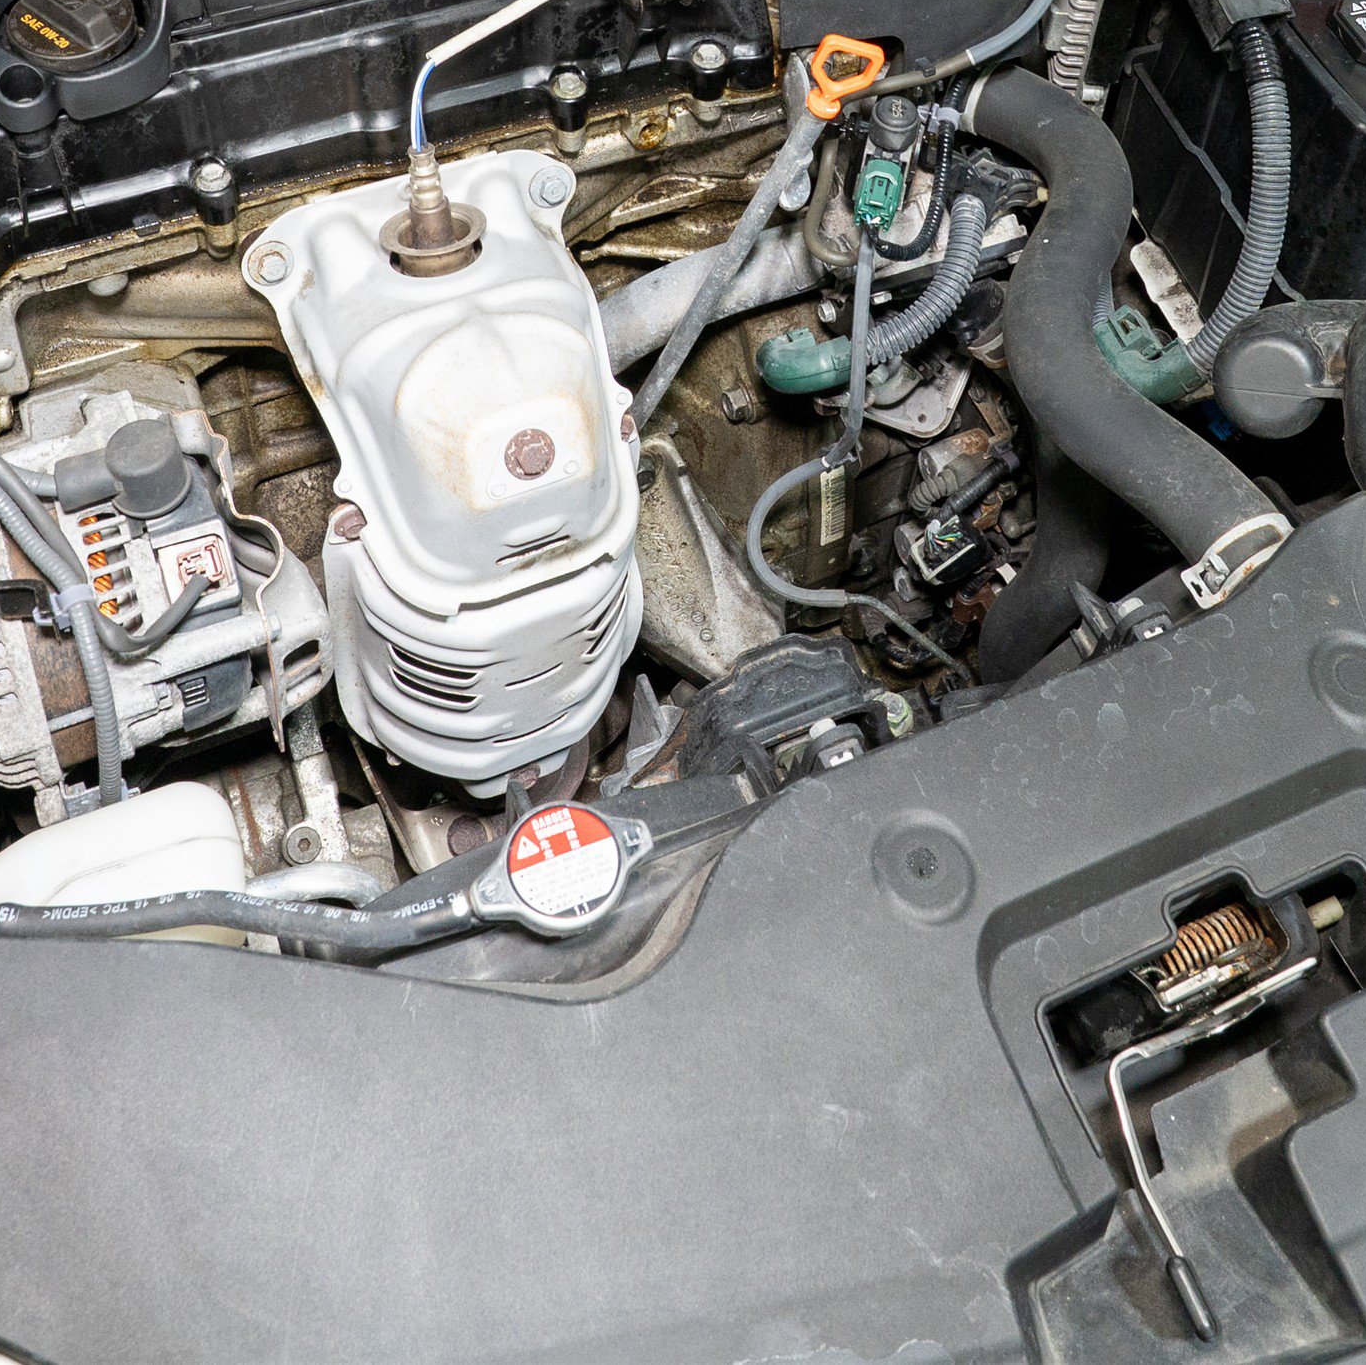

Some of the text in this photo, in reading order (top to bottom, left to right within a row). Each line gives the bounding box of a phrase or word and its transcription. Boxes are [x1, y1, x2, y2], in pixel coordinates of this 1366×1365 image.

[20, 14, 44, 31] SAE
[39, 26, 71, 49] 0W-20
[101, 903, 129, 916] TPC
[572, 900, 590, 917] 1.1
